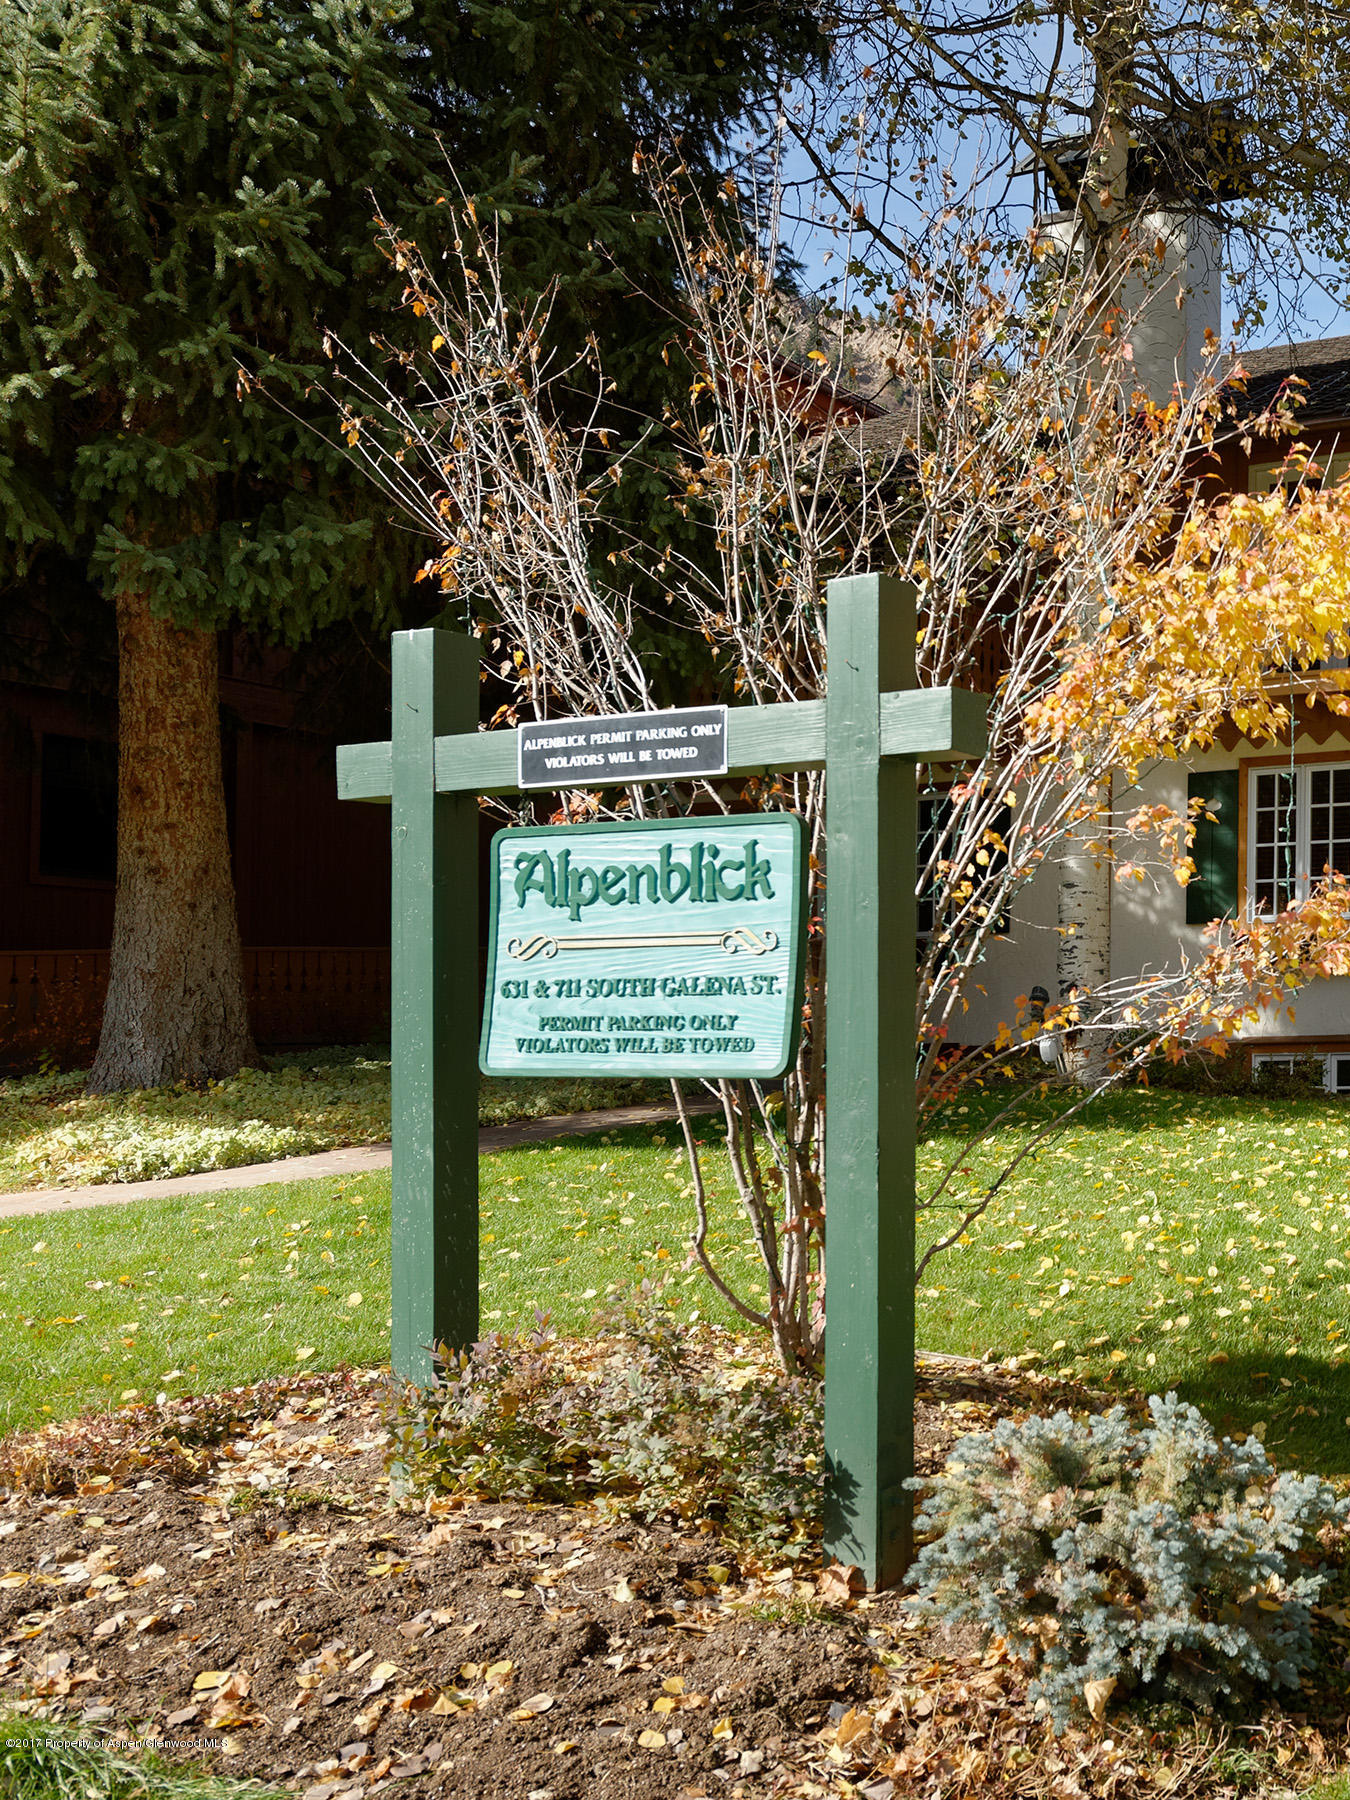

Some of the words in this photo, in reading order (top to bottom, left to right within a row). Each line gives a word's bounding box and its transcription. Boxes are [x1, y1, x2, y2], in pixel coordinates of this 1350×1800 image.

[523, 734, 587, 751] ALPENBLICK
[590, 730, 633, 745] PERMIT
[635, 726, 688, 741] PARKING
[690, 723, 722, 737] ONLY
[544, 754, 604, 769] VIOLATORS
[607, 751, 635, 764] WILL
[639, 749, 653, 761] BE
[656, 746, 698, 760] TOWED
[513, 839, 775, 922] Alpenblick
[500, 979, 529, 998] 631
[533, 979, 550, 998] &
[554, 978, 582, 997] 711
[586, 977, 656, 998] SOUTH
[660, 976, 746, 997] GALENA
[750, 975, 782, 995] ST.
[538, 1015, 604, 1031] PERMIT
[606, 1015, 685, 1031] PARKING
[688, 1014, 739, 1031] ONLY
[515, 1037, 611, 1053] VIOLATORS
[614, 1037, 658, 1053] WILL
[662, 1037, 685, 1053] BE
[689, 1037, 755, 1053] TOWED
